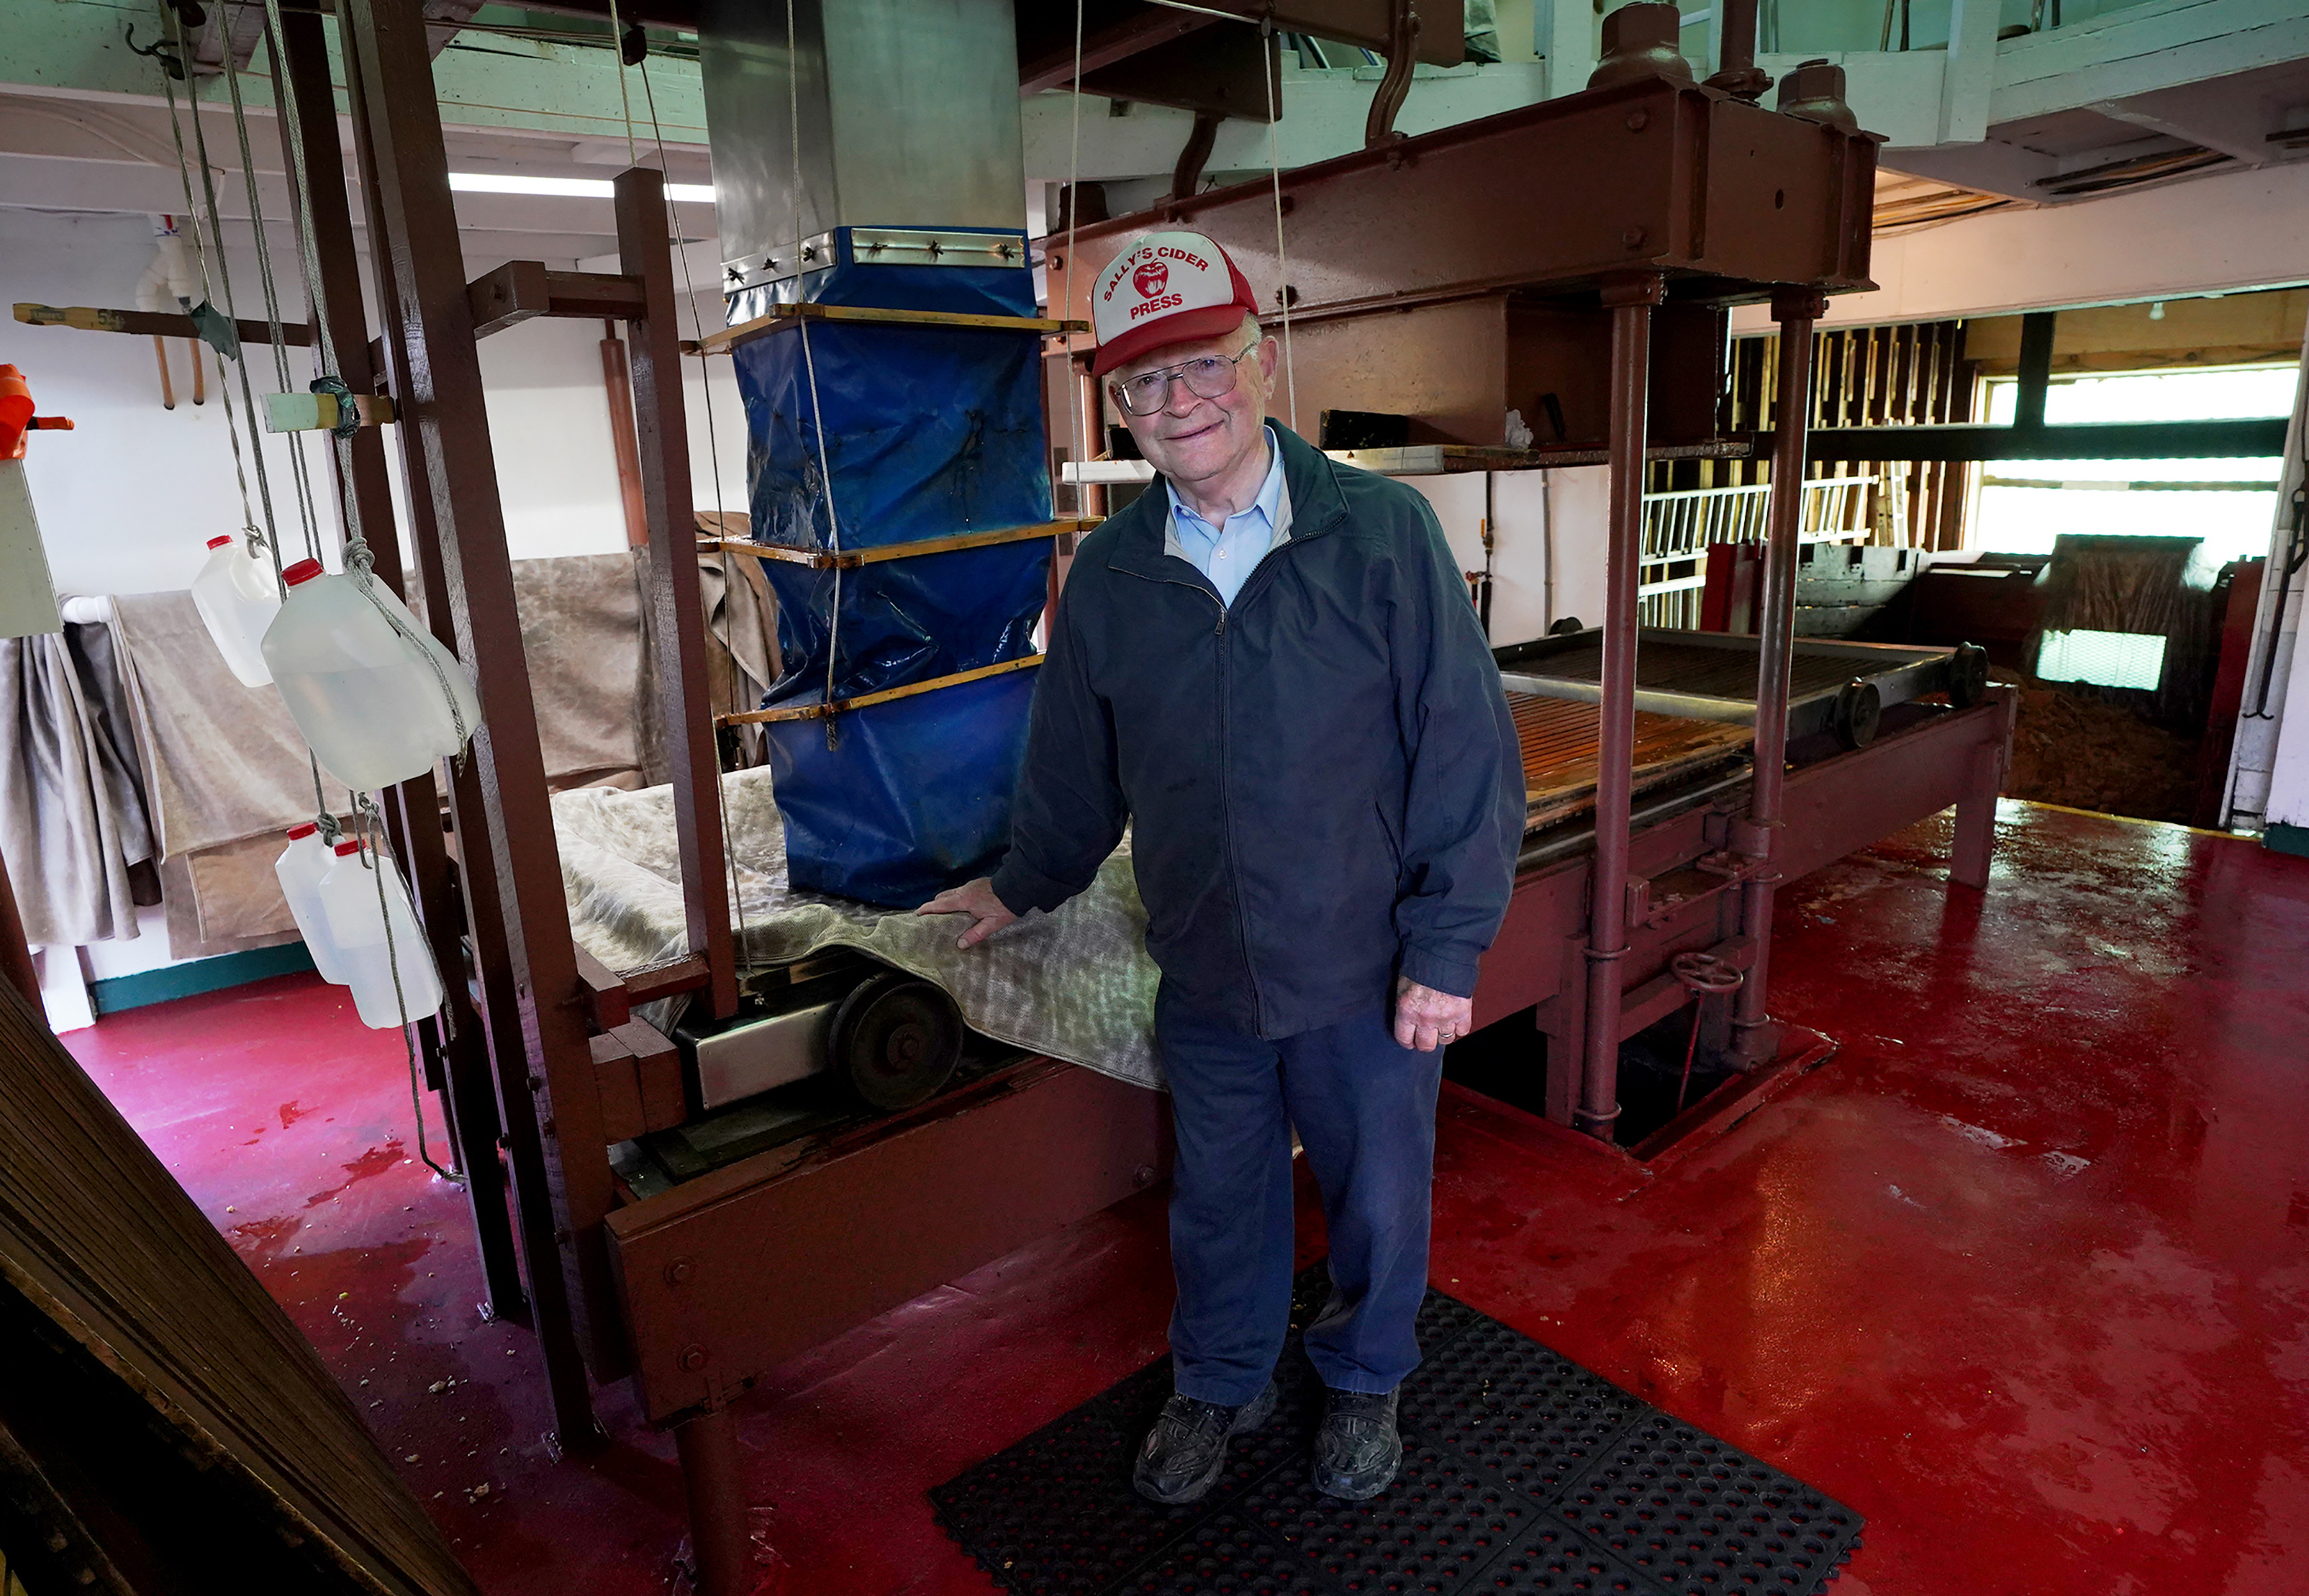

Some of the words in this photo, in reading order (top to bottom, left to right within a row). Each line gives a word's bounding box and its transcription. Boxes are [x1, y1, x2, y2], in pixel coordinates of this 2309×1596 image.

[1104, 247, 1153, 302] SALLY'S
[1158, 246, 1208, 272] CIDER
[1130, 293, 1182, 320] PRESS
